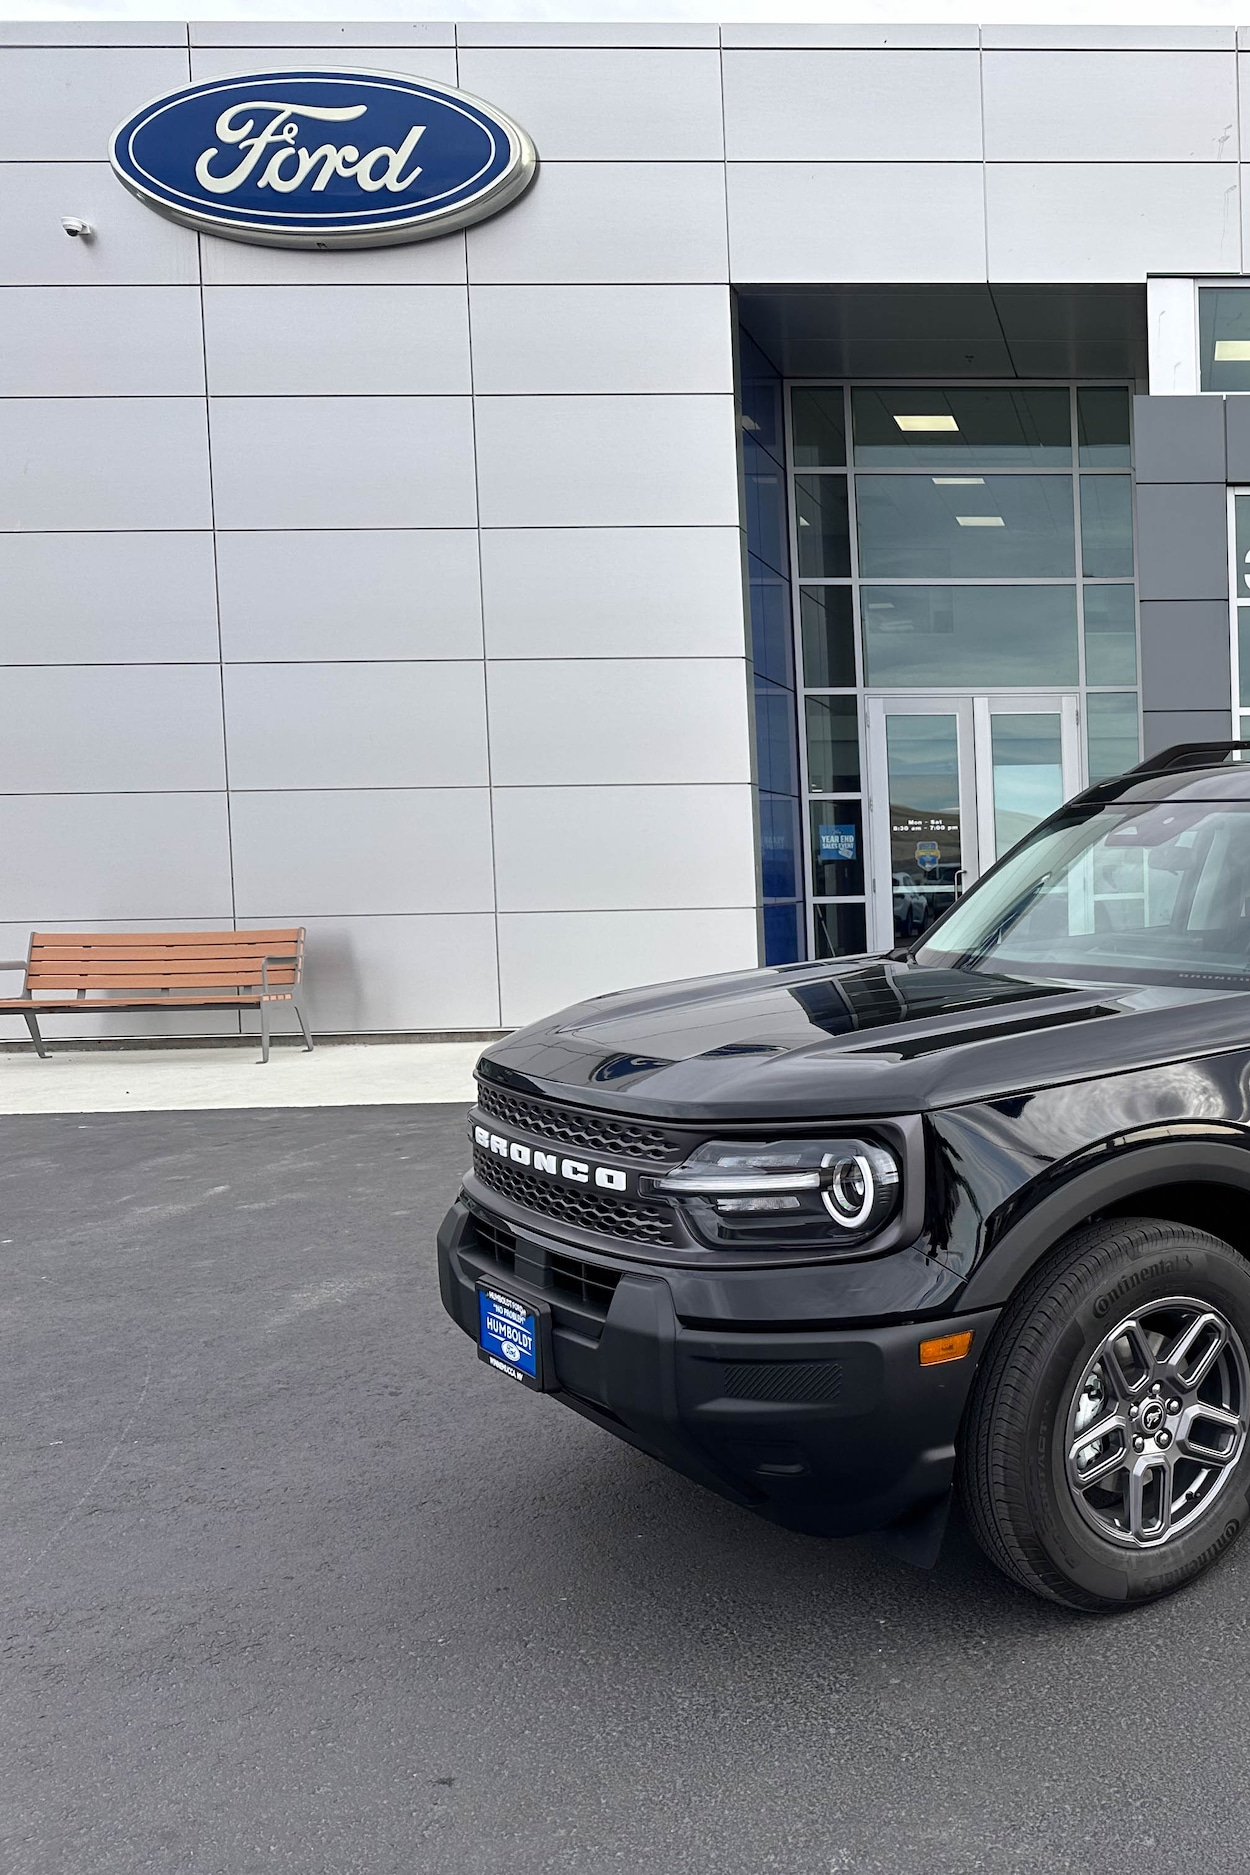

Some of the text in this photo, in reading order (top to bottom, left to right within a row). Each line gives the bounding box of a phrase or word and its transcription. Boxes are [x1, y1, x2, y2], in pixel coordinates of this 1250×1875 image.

[195, 101, 427, 194] Ford
[821, 835, 855, 843] YEAR END
[475, 1125, 627, 1191] BRONCO
[1093, 1254, 1180, 1319] Continental
[486, 1316, 533, 1351] HUMBOLDT
